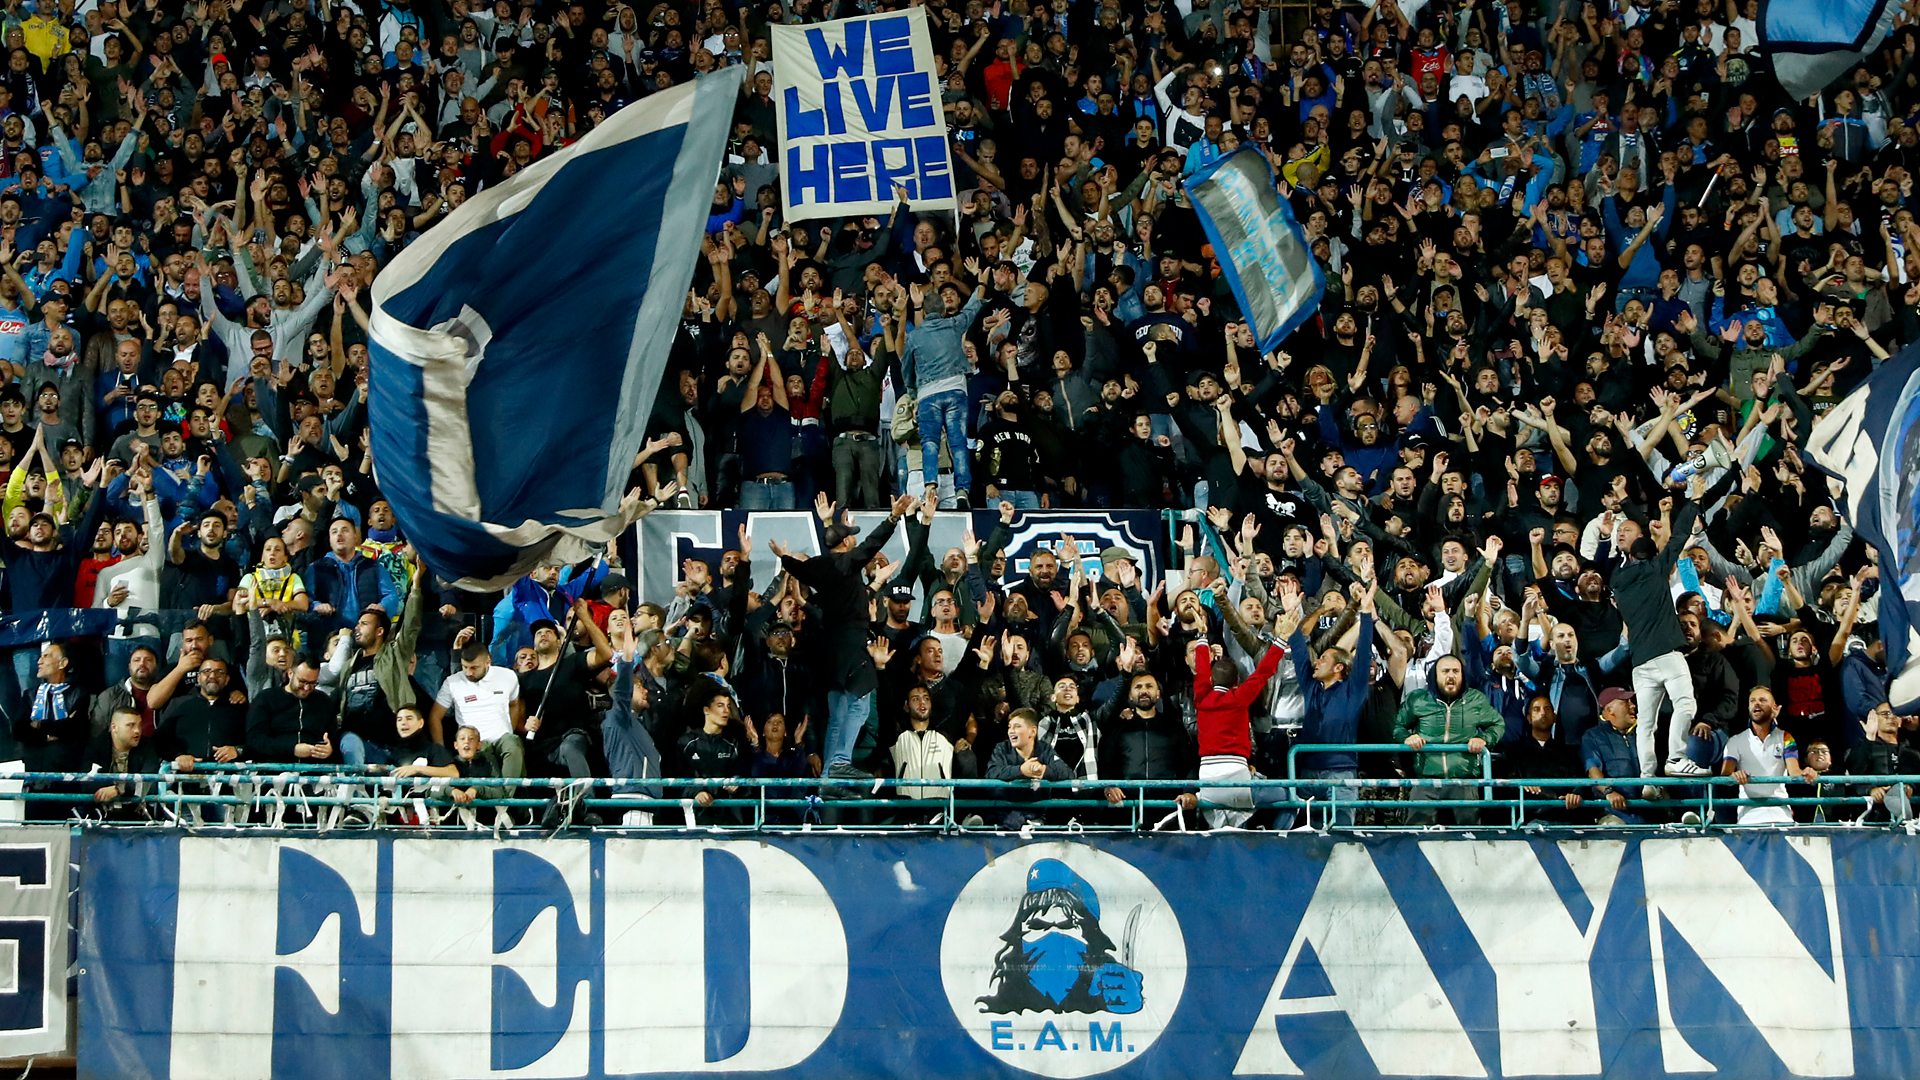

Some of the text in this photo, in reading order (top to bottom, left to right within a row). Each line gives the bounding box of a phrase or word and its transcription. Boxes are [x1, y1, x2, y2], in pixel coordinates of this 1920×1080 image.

[807, 18, 914, 104] WE
[786, 74, 934, 139] LIVE
[789, 138, 950, 206] HERE
[993, 431, 1011, 444] NEW
[991, 1011, 1136, 1053] E.A.M.
